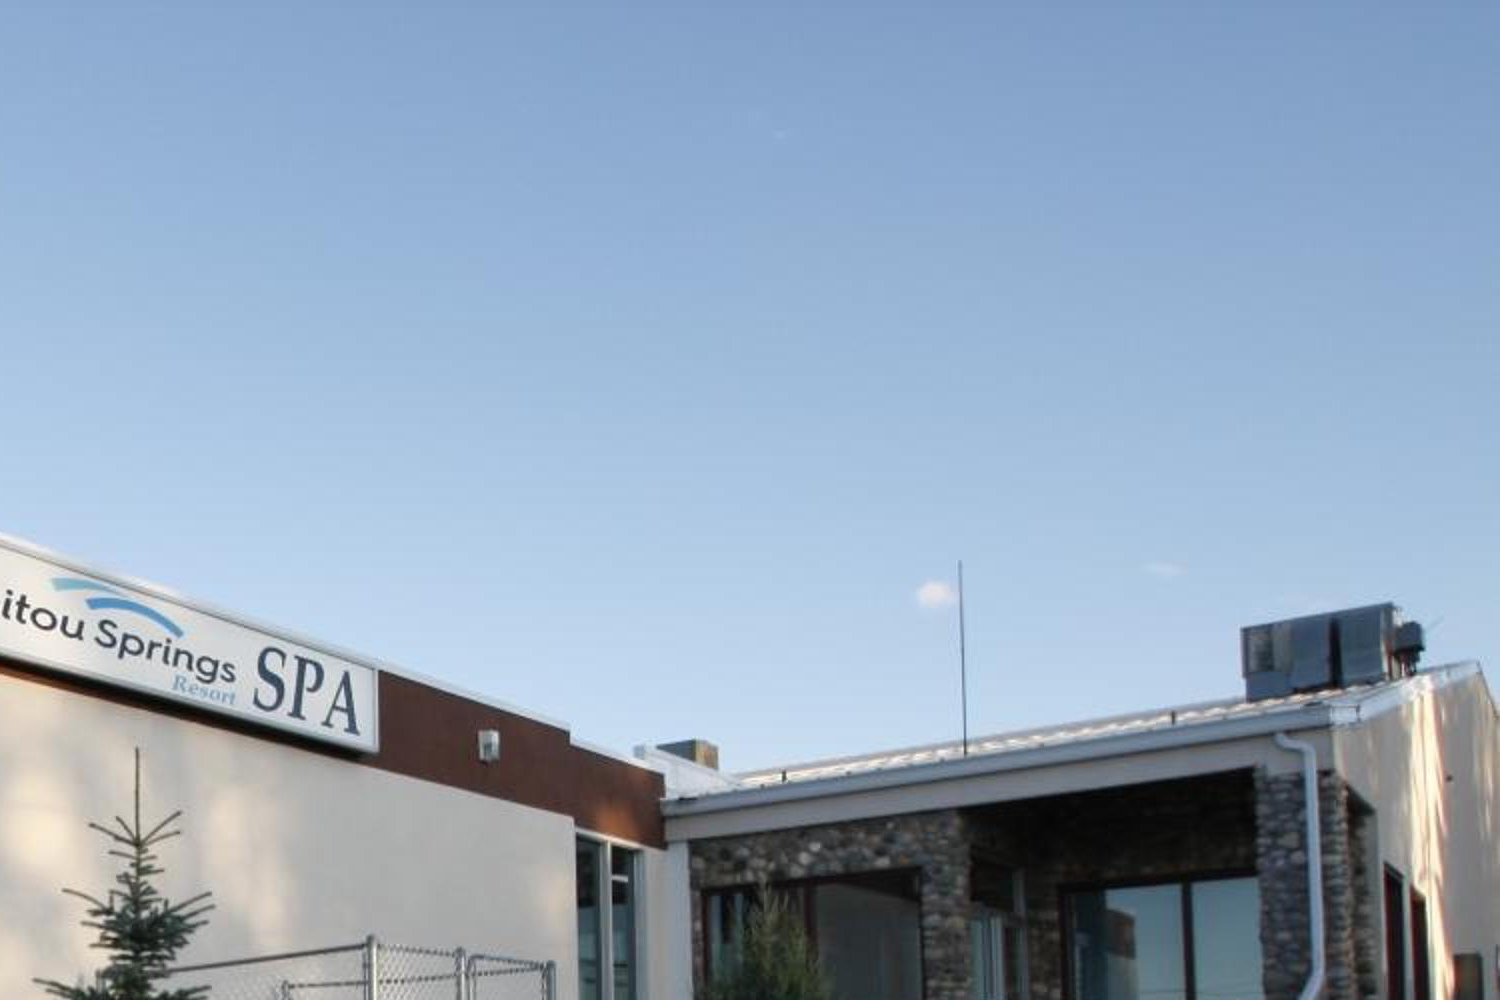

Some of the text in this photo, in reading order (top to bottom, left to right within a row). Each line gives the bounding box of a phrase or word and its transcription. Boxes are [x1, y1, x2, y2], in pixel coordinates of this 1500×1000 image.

[94, 619, 237, 685] Springs
[171, 674, 237, 706] Resort
[253, 645, 361, 737] SPA
